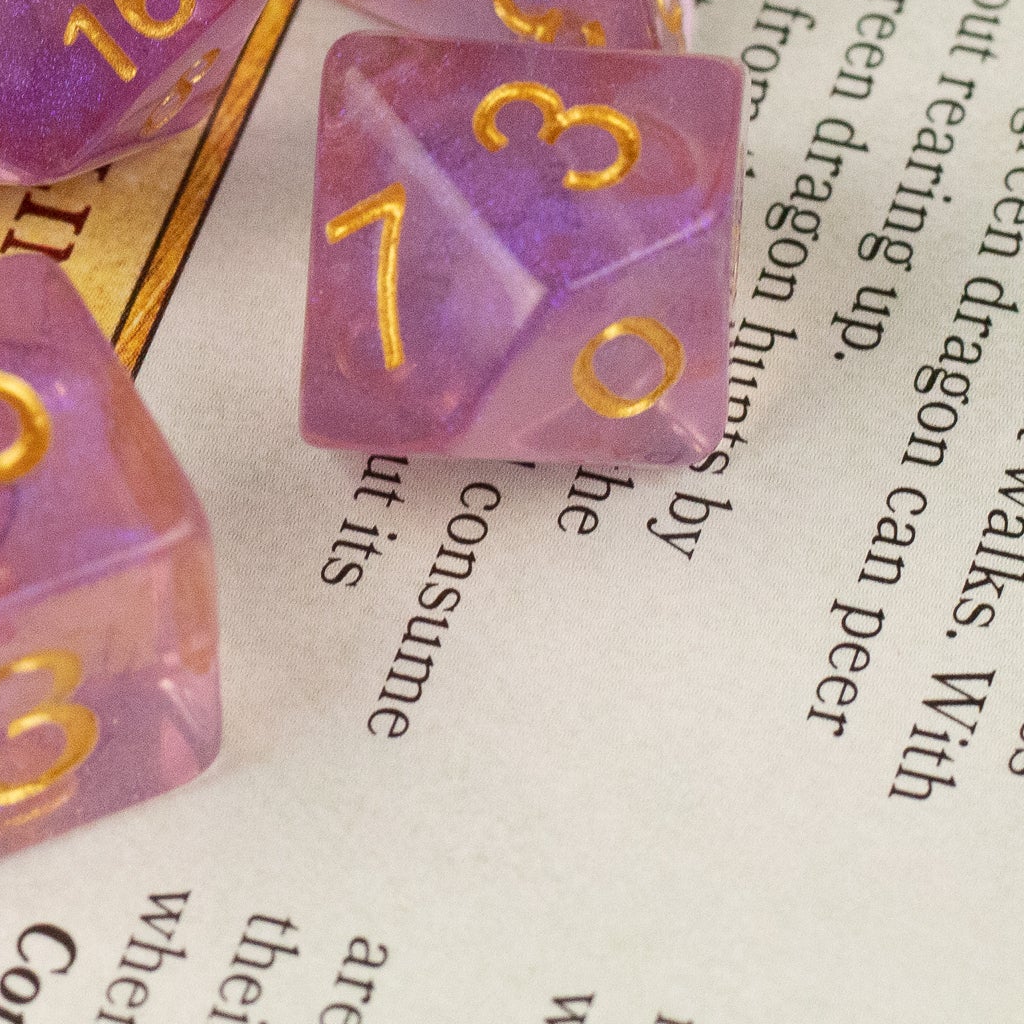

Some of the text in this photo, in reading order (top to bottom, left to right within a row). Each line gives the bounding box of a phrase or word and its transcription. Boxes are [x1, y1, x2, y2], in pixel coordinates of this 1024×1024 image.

[472, 81, 641, 191] 3
[858, 74, 976, 273] rearing
[325, 182, 406, 370] 7
[752, 117, 870, 304] dragon
[573, 316, 685, 418] 0
[831, 284, 898, 362] up.
[901, 274, 1020, 468] dragon
[320, 520, 397, 588] its
[647, 491, 733, 561] by
[857, 484, 929, 586] can
[367, 481, 502, 739] consume
[806, 597, 888, 739] peer
[888, 669, 999, 801] With
